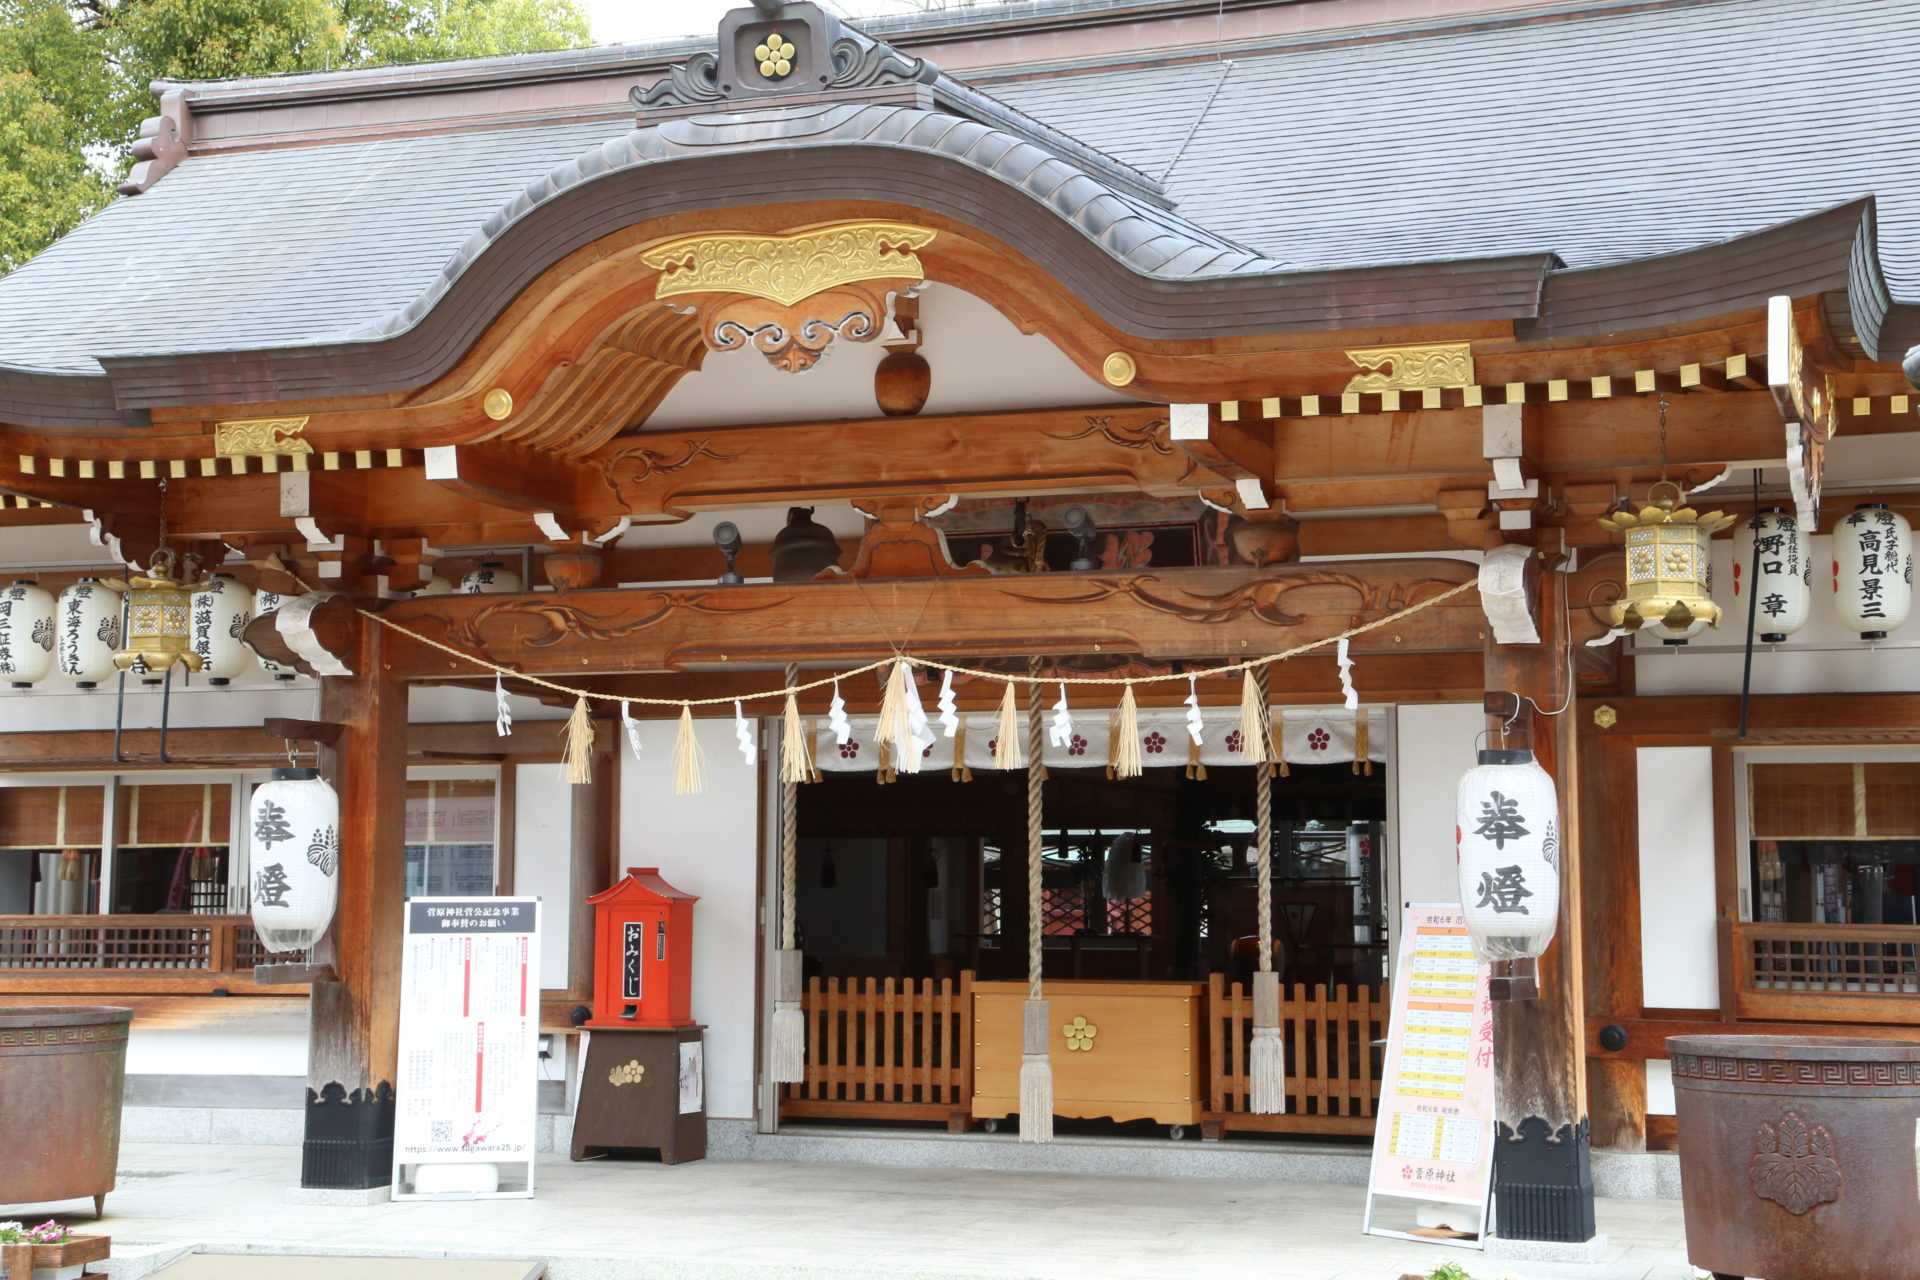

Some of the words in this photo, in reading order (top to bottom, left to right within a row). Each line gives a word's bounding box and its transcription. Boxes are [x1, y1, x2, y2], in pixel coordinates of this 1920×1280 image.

[1787, 533, 1799, 576] 責任役員
[1858, 529, 1886, 620] 高見景三
[0, 600, 16, 675] 岡三証券株)
[66, 599, 84, 675] 東海ろうきん
[254, 799, 296, 908] 奉燈
[1473, 791, 1534, 915] 奉燈
[426, 906, 520, 917] 菅原神社菅公記念事業
[441, 918, 506, 928] 御奉賛のお願い
[1426, 914, 1453, 924] 令和6年
[626, 926, 641, 996] おみくじ
[1415, 1167, 1456, 1183] 菅原神社
